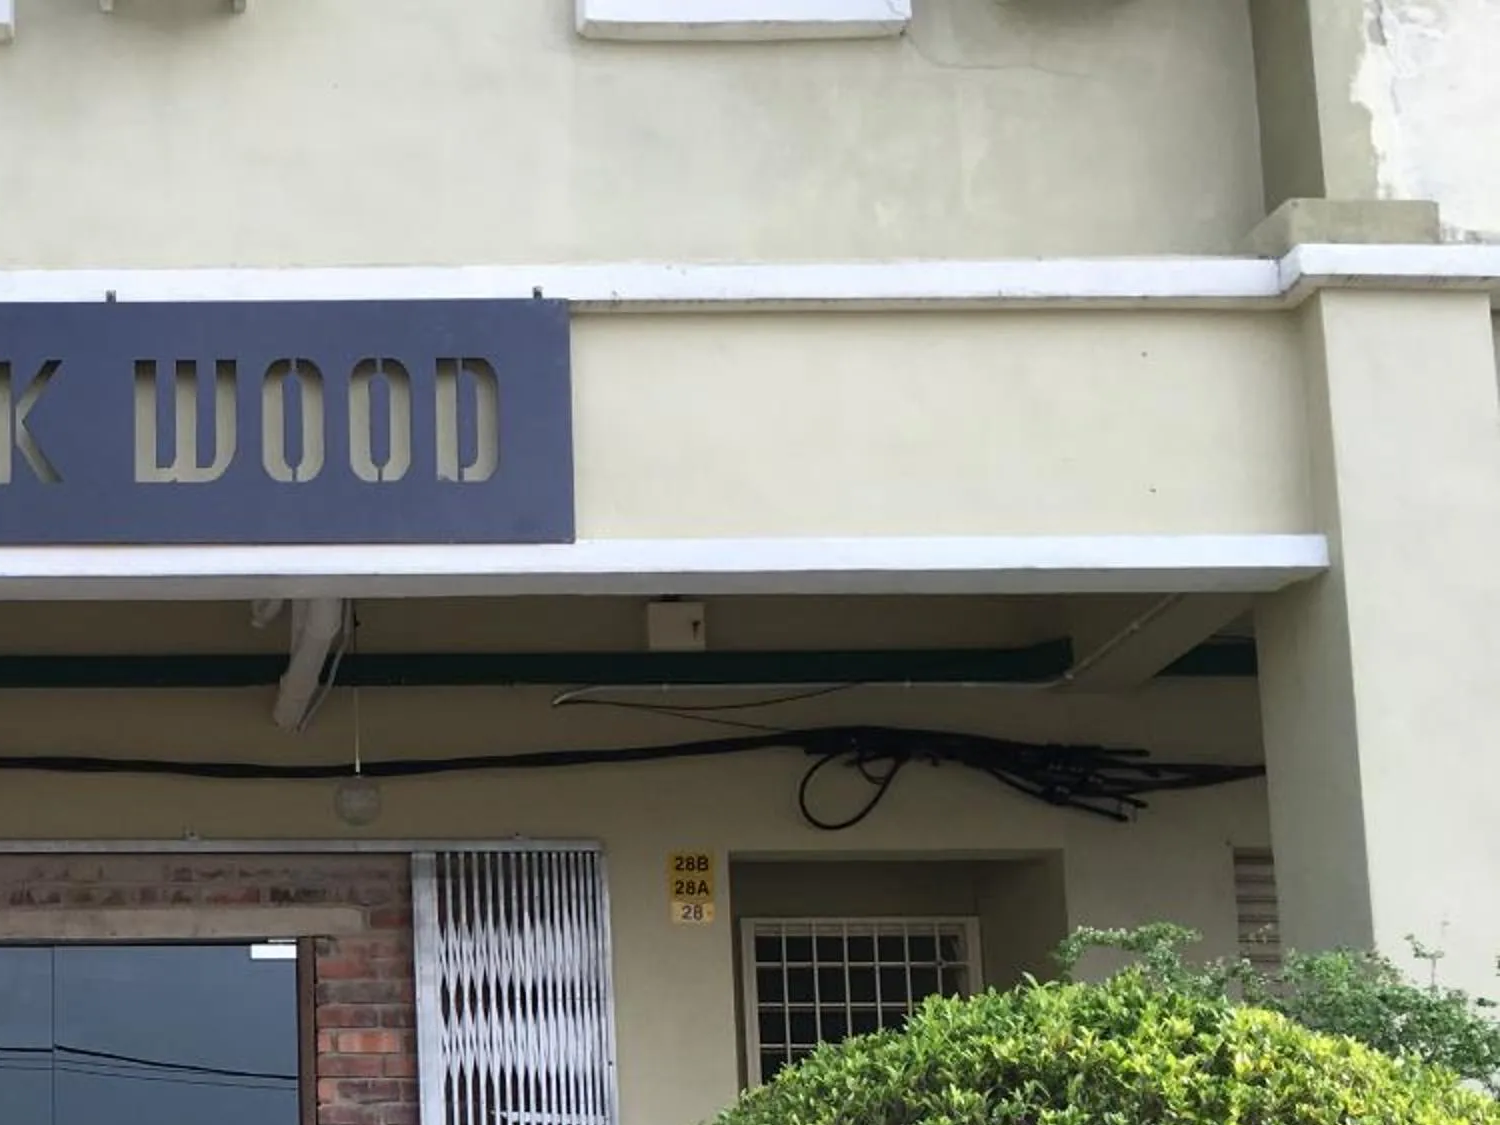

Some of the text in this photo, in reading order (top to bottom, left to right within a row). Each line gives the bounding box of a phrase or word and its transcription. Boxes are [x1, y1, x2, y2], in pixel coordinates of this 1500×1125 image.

[134, 357, 499, 483] WOOD
[675, 854, 709, 872] 28B
[675, 879, 710, 896] 28A
[682, 904, 703, 921] 28
